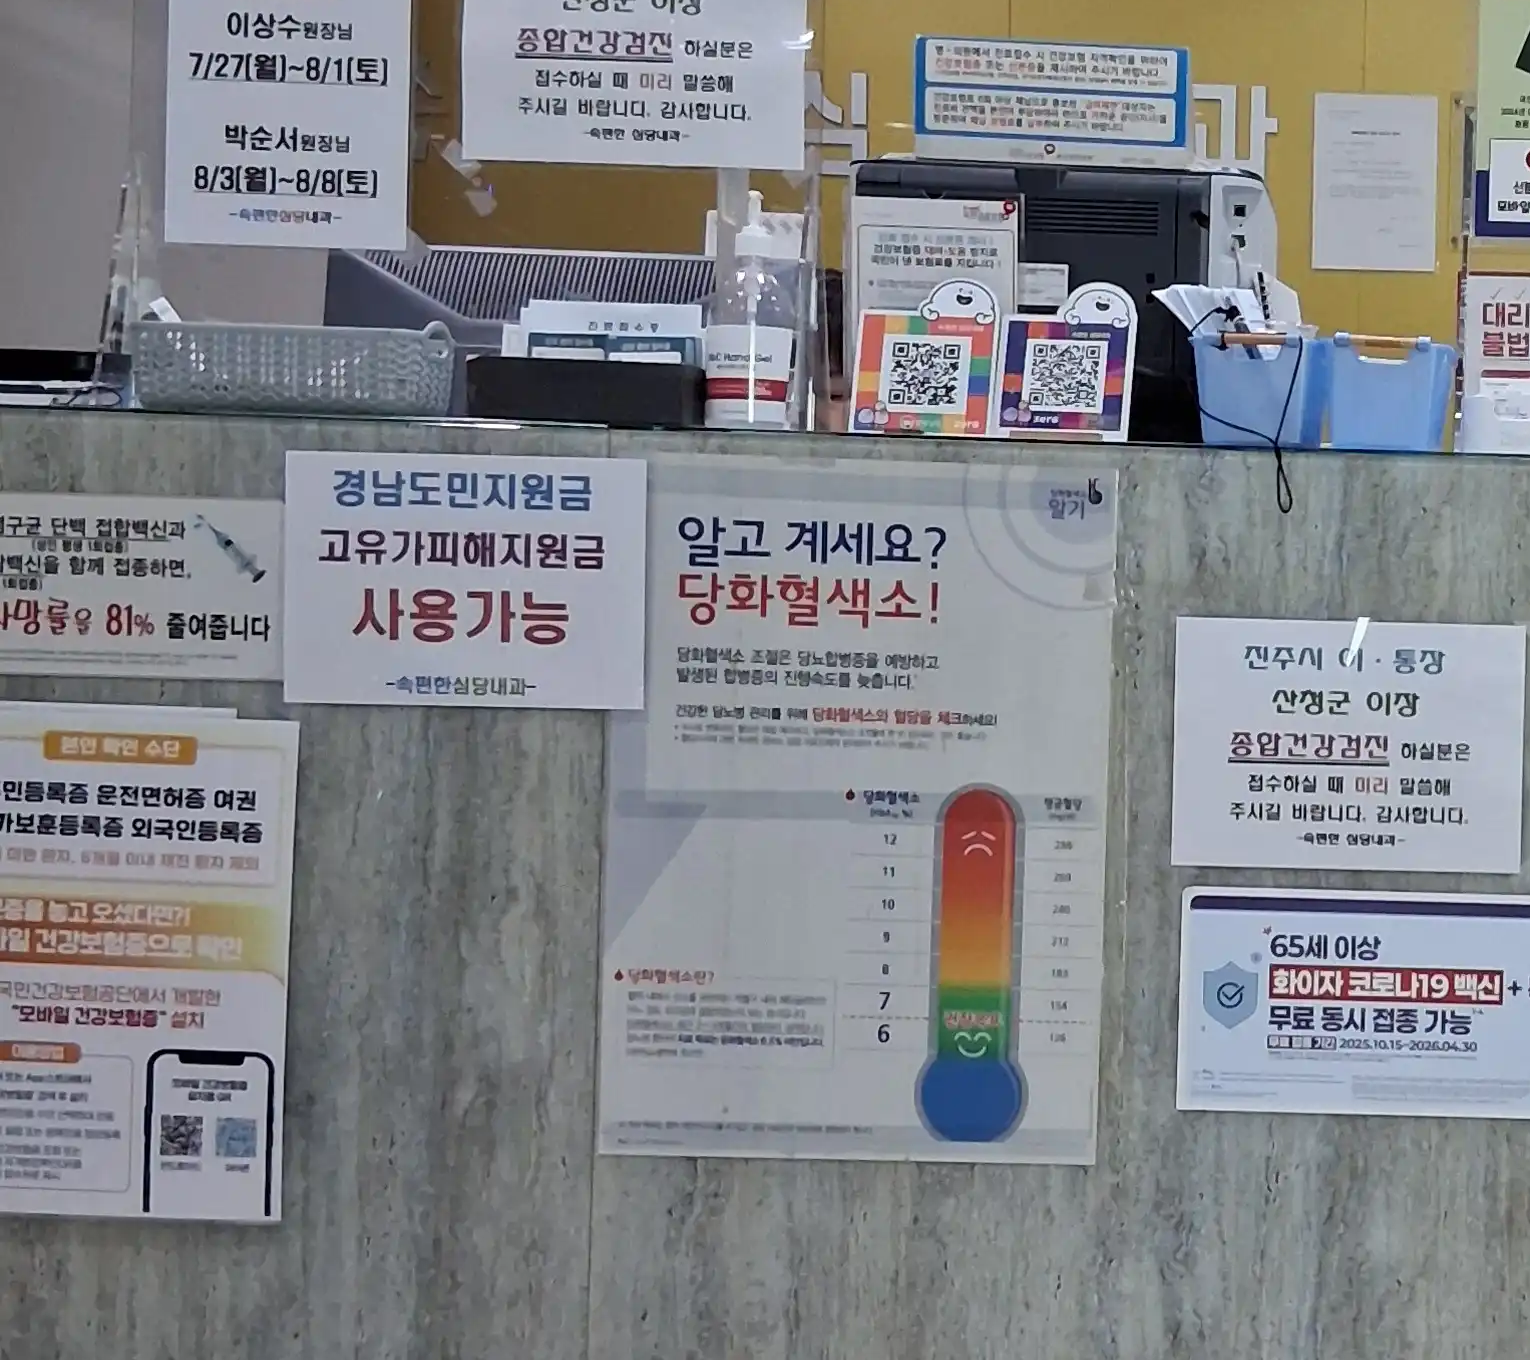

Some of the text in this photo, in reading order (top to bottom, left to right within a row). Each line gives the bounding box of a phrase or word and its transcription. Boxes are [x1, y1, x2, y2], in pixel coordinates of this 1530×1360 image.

[517, 28, 753, 58] 종합건강검진 하실분은
[535, 69, 734, 92] 접수하실 때 미리 말씀해
[518, 97, 752, 121] 주시길 바랍니다. 감사합니다.
[333, 469, 593, 511] 경남도민지원금
[50, 518, 86, 536] 단백
[96, 518, 186, 540] 접합백신과
[317, 529, 605, 570] 고유가피해지원금
[677, 516, 947, 569] 알고 계세요?
[69, 556, 104, 575] 함께
[114, 558, 192, 579] 접종하면,
[677, 573, 940, 628] 당화혈색소!
[105, 604, 271, 641] 81% 줄여줍니다
[352, 588, 570, 645] 사용가능
[677, 646, 939, 670] 당화혈색소 조절은 당뇨합병증을 예방하고
[1244, 646, 1322, 670] 진주시
[677, 667, 717, 685] 발생된
[785, 670, 851, 689] 진행속도를
[1272, 690, 1420, 717] 산청군 이장
[61, 736, 180, 758] 본인 확인 수단
[1229, 732, 1470, 762] 종합건강검진 하실분은
[0, 781, 257, 811] 민등록증 운전면허증 여권
[1248, 774, 1451, 796] 접수하실 때 미리 말씀해
[1229, 802, 1469, 825] 주시길 바랍니다. 감사합니다.
[132, 819, 263, 843] 외국인등록증
[883, 931, 890, 943] 9
[1270, 935, 1381, 961] 65세 이상
[1272, 969, 1343, 997] 화이자
[1348, 972, 1449, 999] 코로나19
[1454, 975, 1500, 1001] 백신
[879, 992, 890, 1010] 7
[171, 1012, 204, 1029] 설치
[1269, 1006, 1472, 1035] 무료 동시 접종 가능
[877, 1025, 890, 1044] 6
